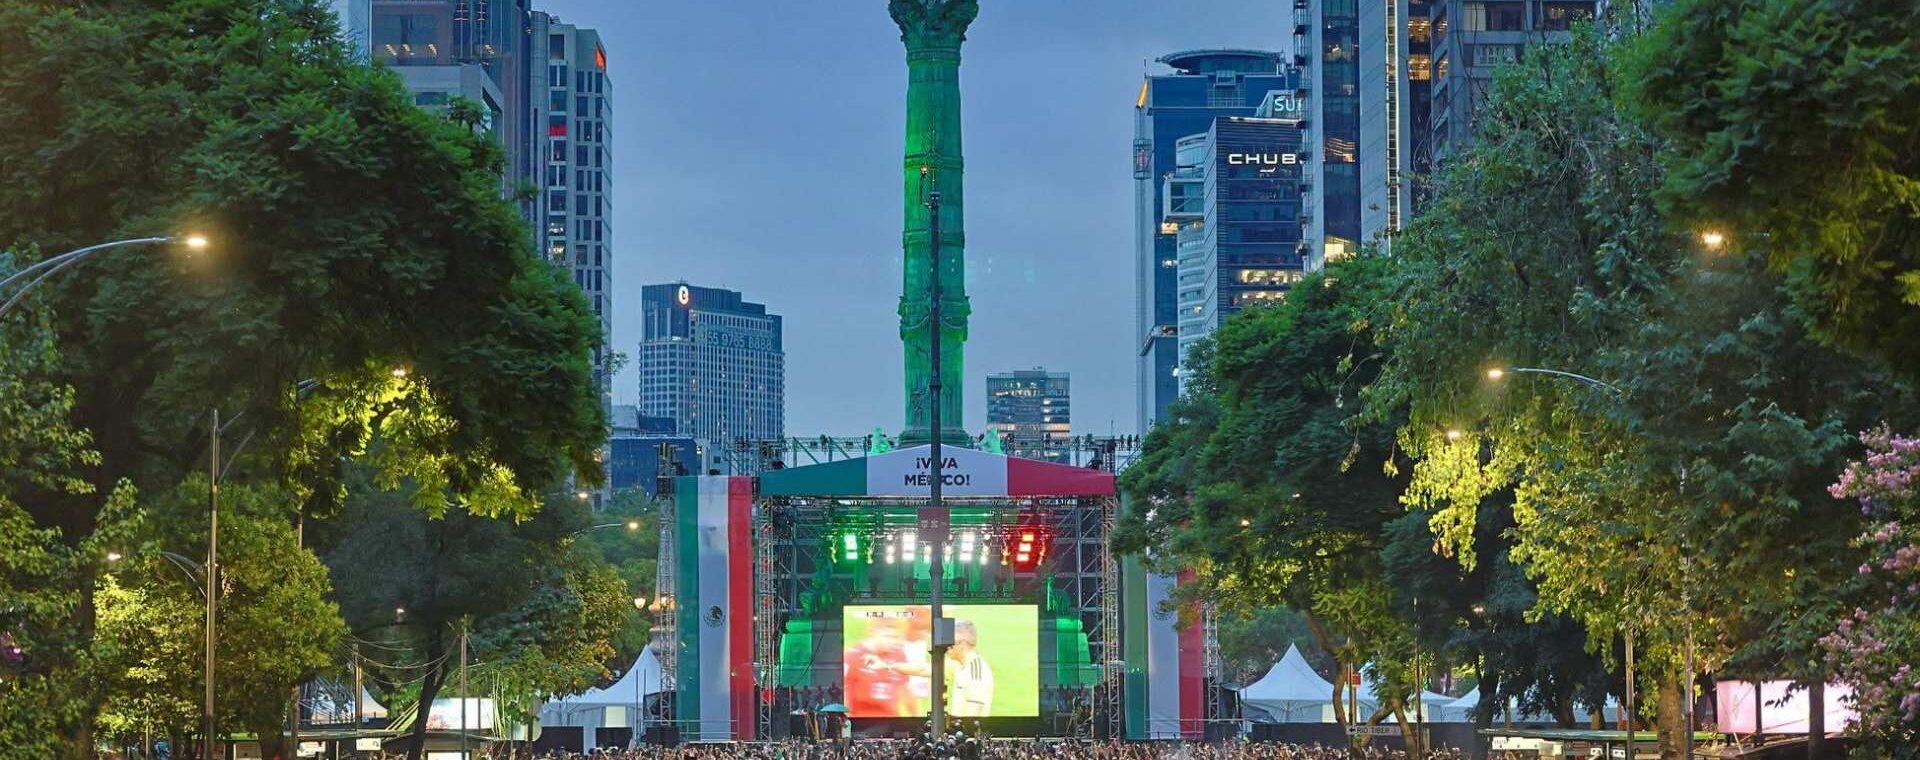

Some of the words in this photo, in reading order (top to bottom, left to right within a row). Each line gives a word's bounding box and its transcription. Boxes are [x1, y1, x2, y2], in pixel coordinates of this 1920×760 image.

[1229, 153, 1303, 164] CHUB
[916, 457, 958, 469] ¡VVA
[904, 471, 971, 486] MÉCO!
